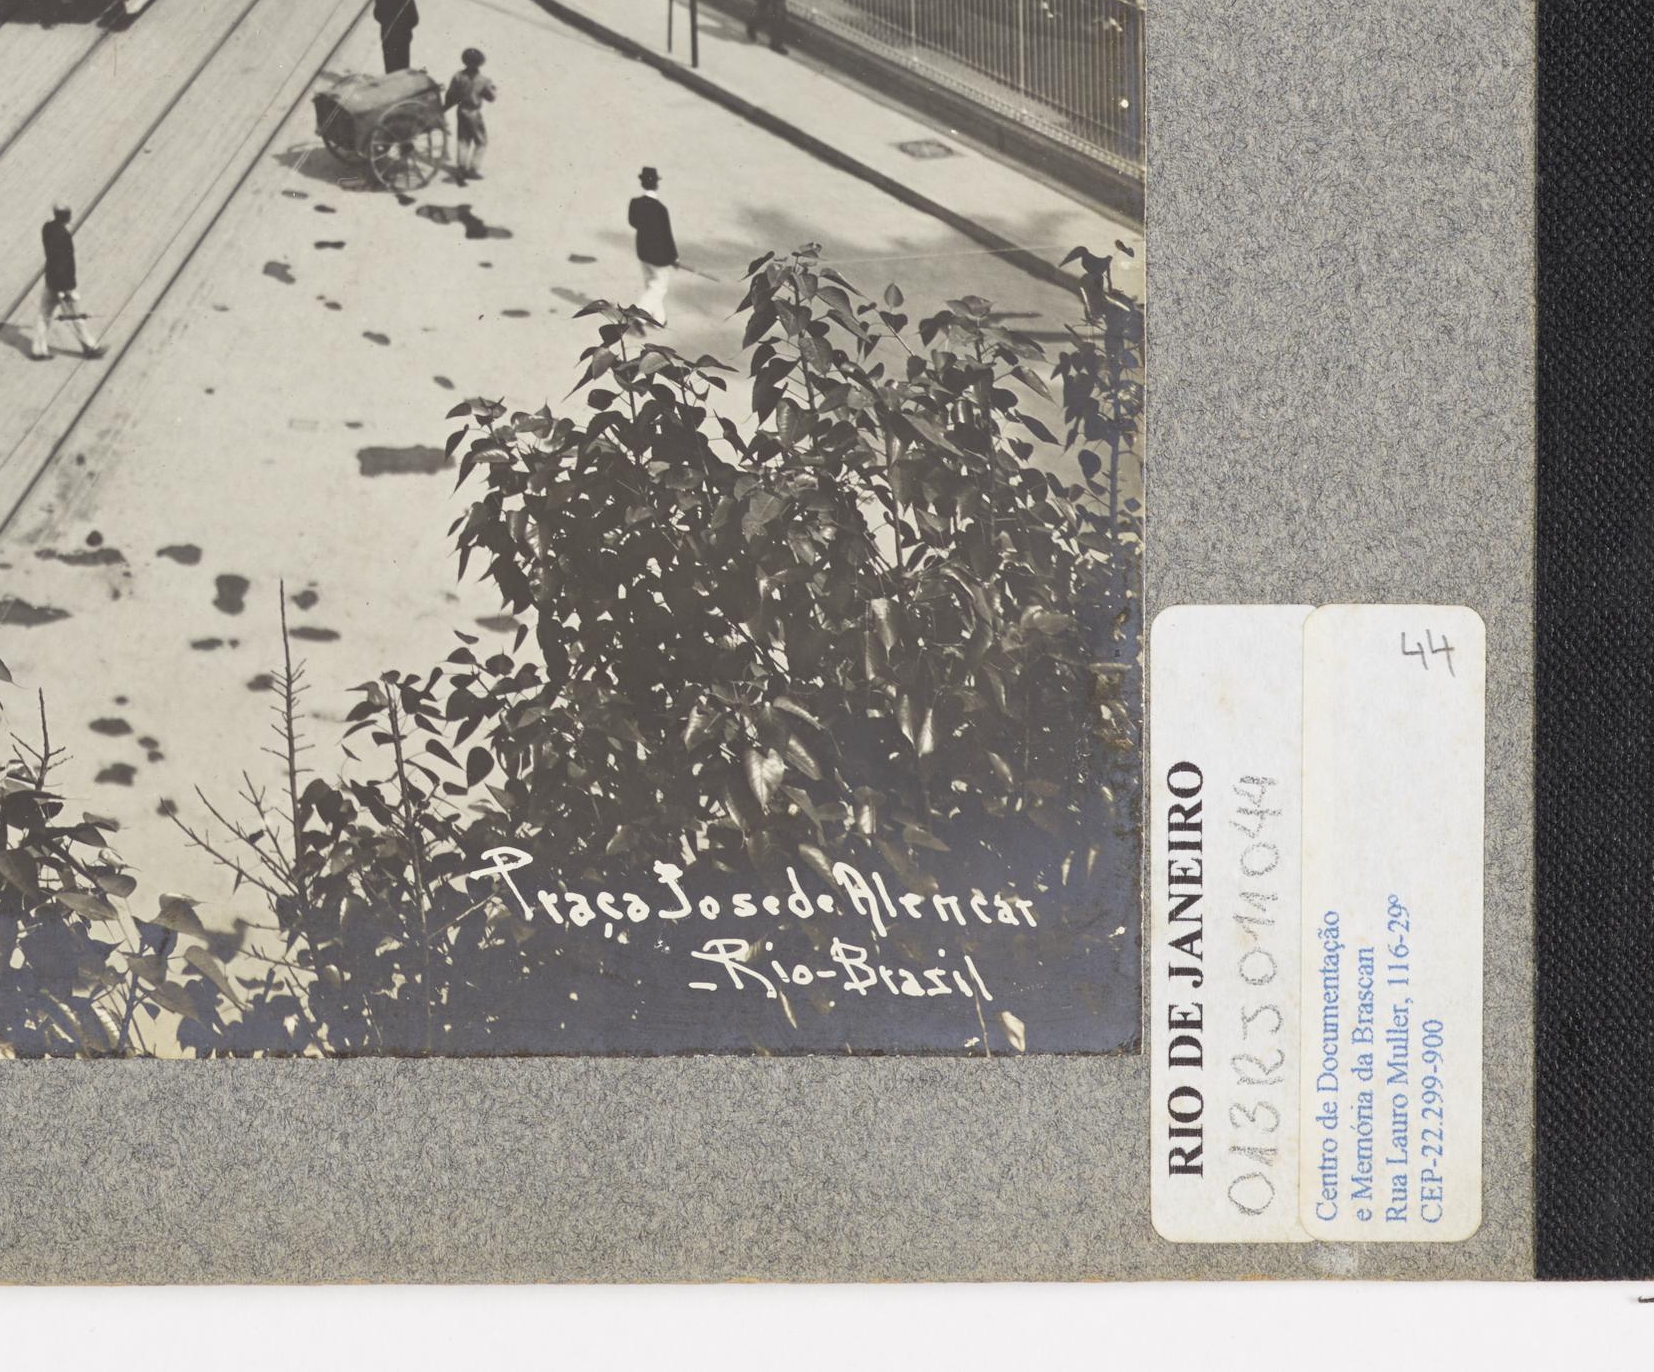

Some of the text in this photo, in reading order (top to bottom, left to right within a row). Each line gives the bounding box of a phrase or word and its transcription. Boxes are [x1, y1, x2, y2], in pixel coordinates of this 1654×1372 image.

[1400, 628, 1456, 678] 44
[1167, 761, 1204, 1179] RIO DE JANEIRO
[1386, 998, 1414, 1087] Muller,
[1315, 910, 1346, 1222] Centro de Documentação
[1350, 946, 1375, 1223] e Memória da Brascan
[1385, 1092, 1409, 1165] Lauro
[1420, 1018, 1445, 1224] CEP-22.299-900
[1385, 1173, 1408, 1224] Rua
